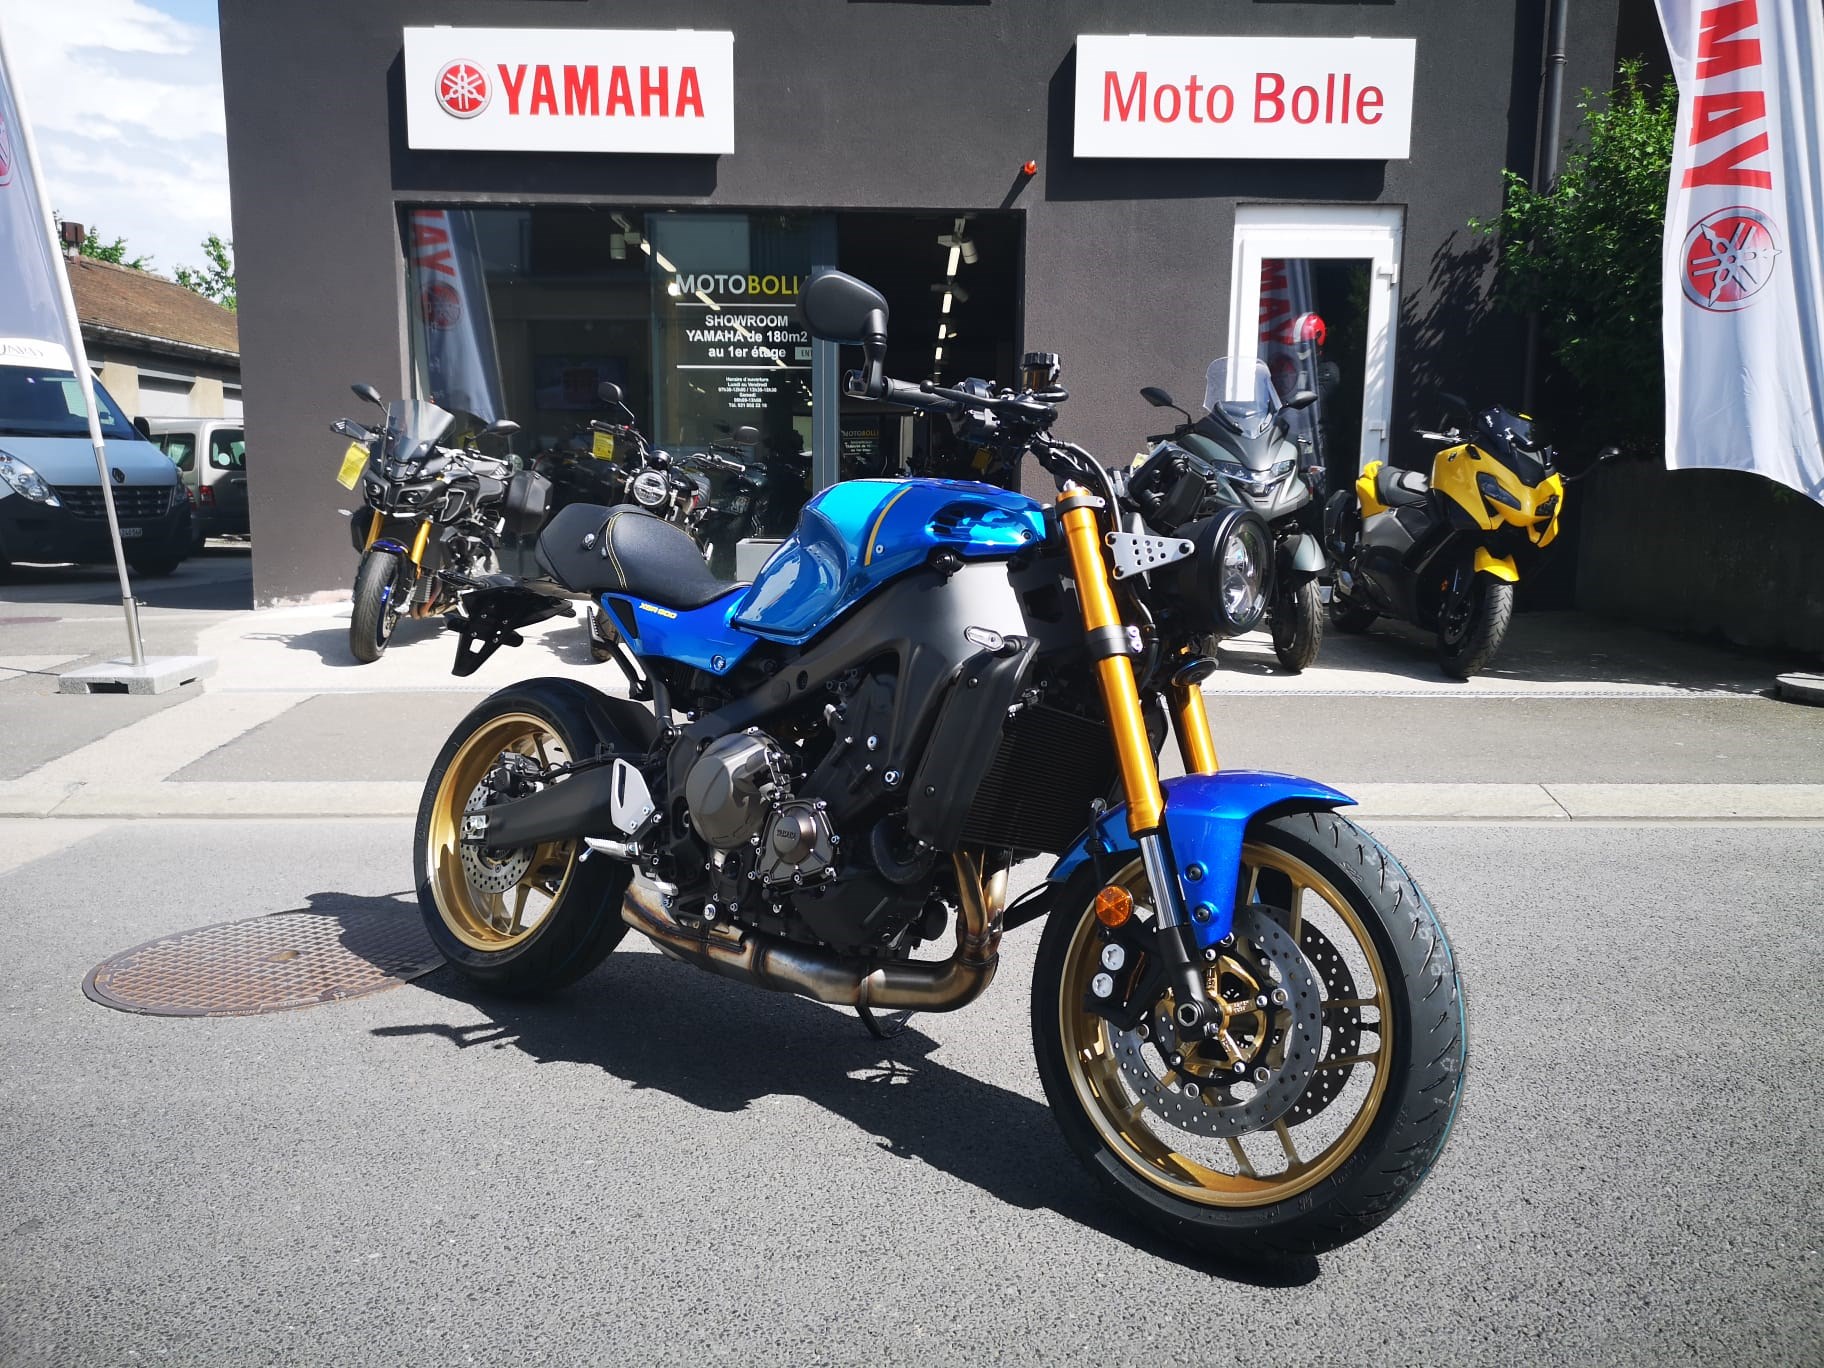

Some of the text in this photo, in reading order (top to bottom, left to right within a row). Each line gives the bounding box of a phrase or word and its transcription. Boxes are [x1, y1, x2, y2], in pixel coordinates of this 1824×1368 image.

[497, 64, 705, 118] YAMAHA
[1103, 71, 1384, 125] Moto Bolle
[676, 274, 801, 295] MOTOBOLL
[705, 315, 788, 327] SHOWROOM
[686, 329, 808, 343] YAMAHA de 180m2
[708, 345, 786, 361] au 1er étage
